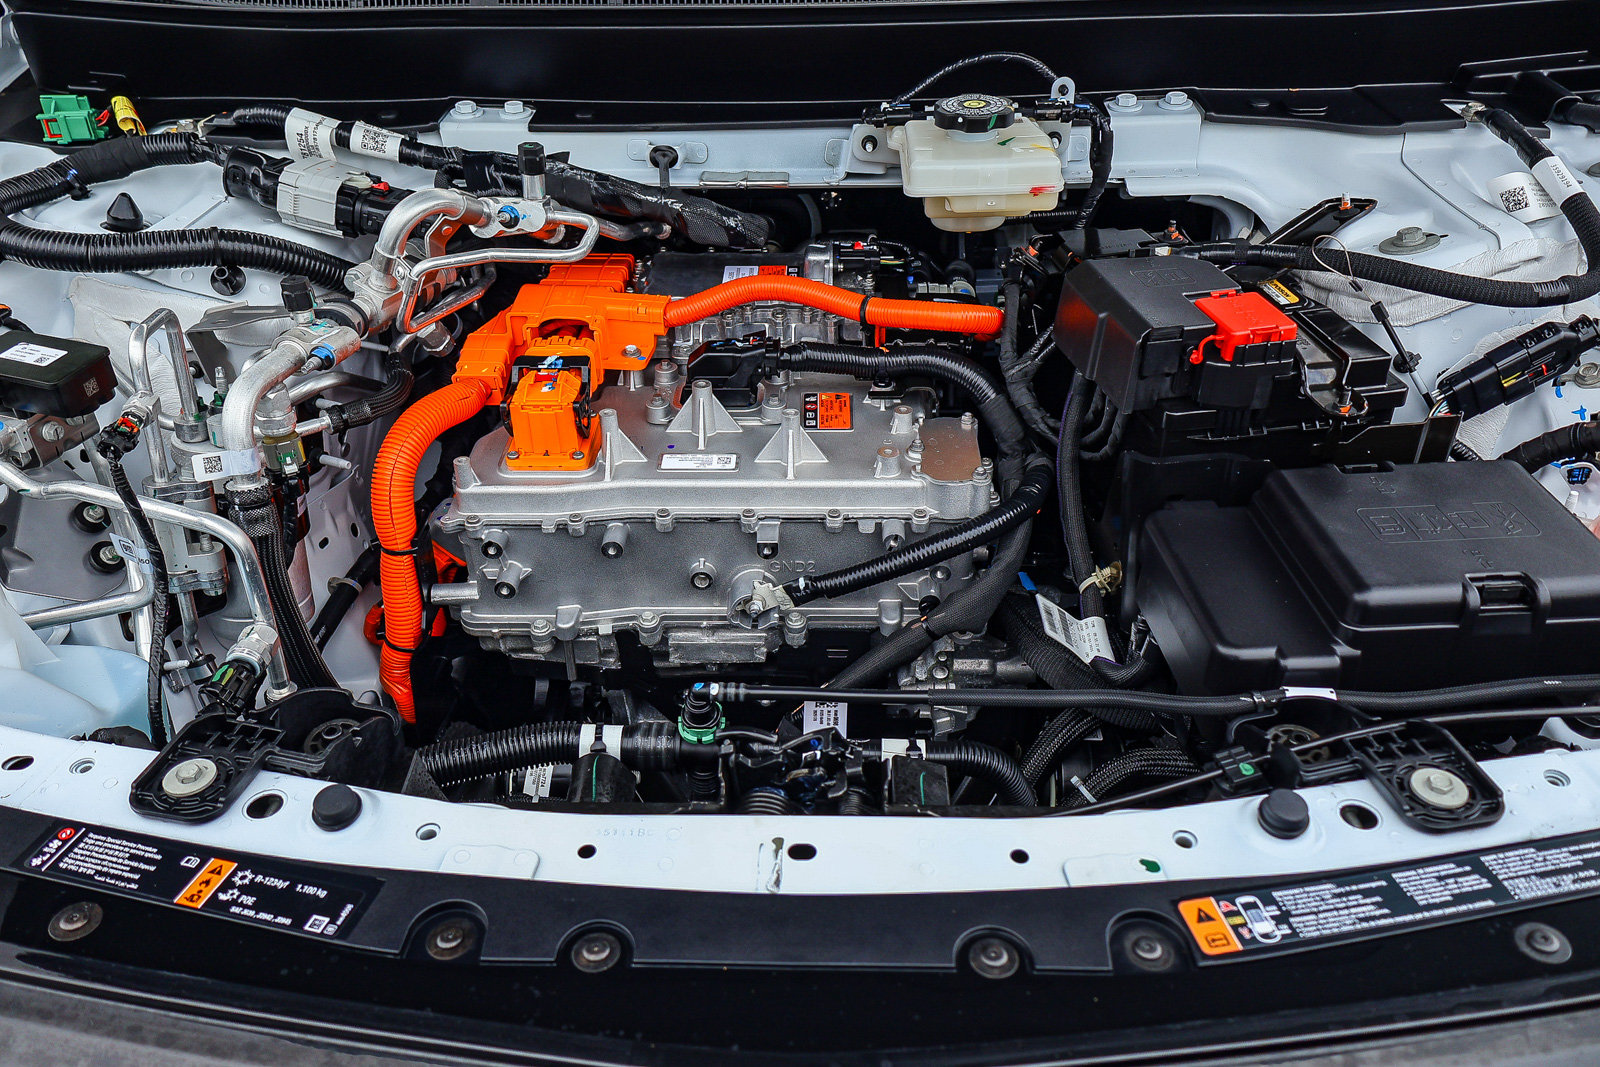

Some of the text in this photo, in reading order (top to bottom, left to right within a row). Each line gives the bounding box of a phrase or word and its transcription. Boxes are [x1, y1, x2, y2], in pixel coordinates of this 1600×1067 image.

[769, 560, 816, 572] GND2
[254, 874, 328, 899] R-1234yf 1.100 kg
[238, 895, 257, 906] POE
